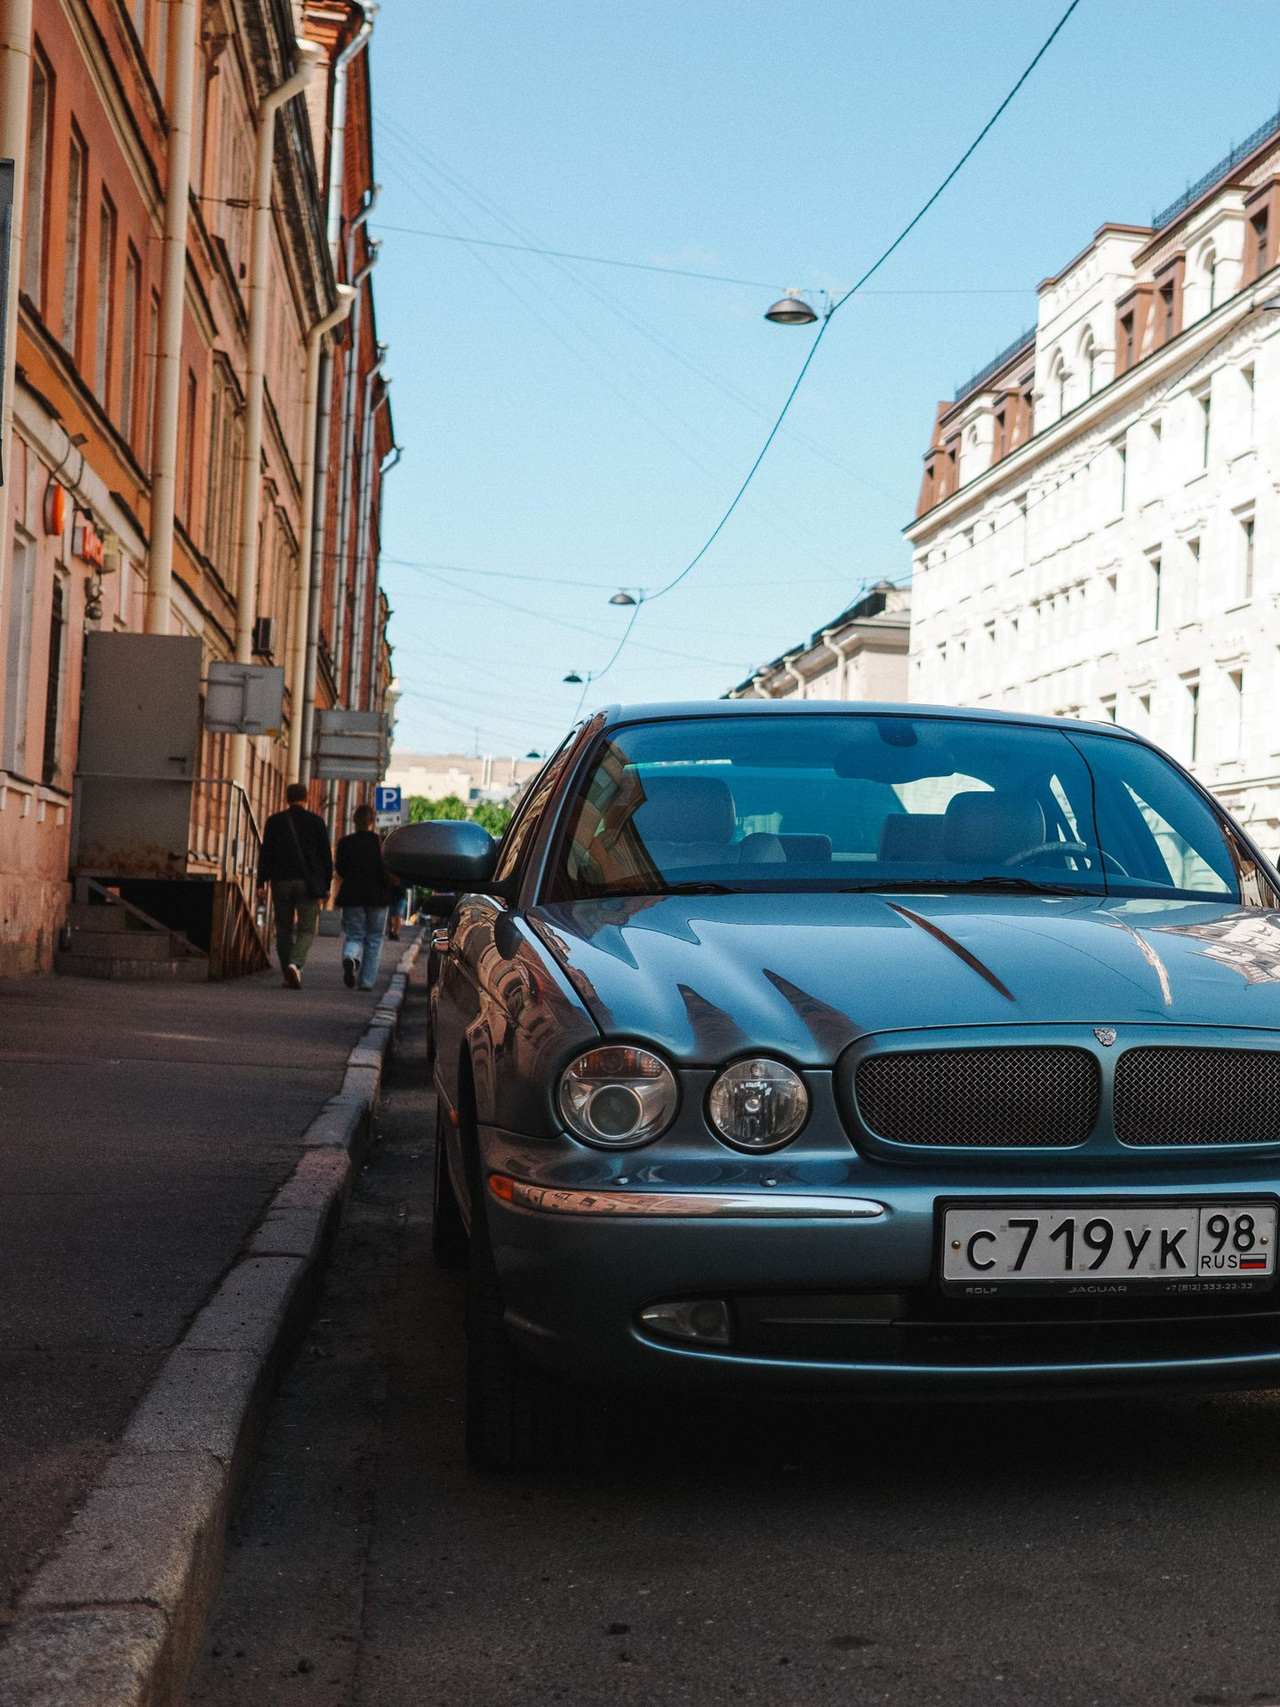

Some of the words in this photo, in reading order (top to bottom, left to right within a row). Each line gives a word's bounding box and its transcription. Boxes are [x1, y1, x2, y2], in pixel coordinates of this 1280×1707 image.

[382, 788, 398, 810] P
[1207, 1213, 1255, 1253] 98
[1201, 1255, 1238, 1269] RUS
